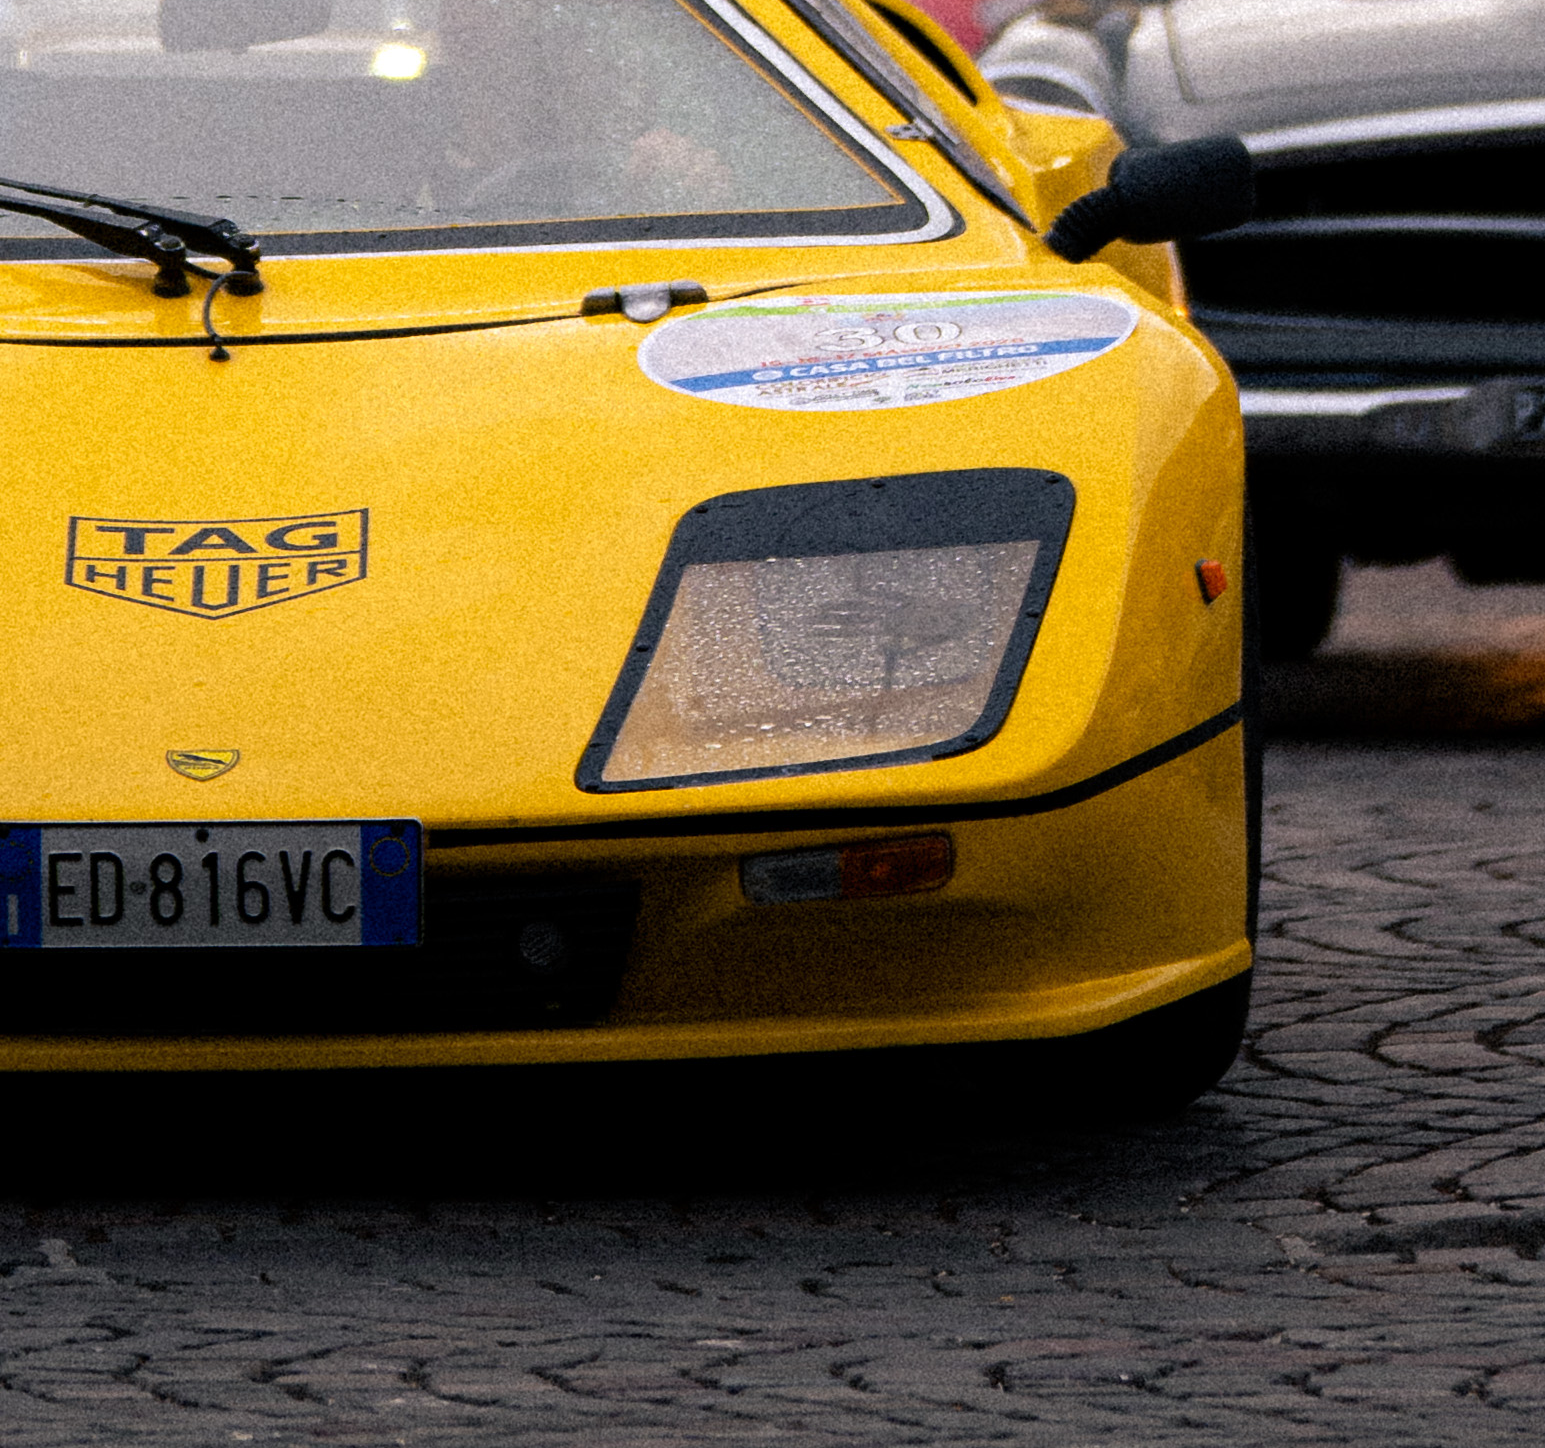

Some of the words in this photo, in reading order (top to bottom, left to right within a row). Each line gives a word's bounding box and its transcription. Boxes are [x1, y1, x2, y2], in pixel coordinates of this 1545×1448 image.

[814, 321, 963, 351] 30
[790, 359, 870, 377] CASA
[876, 351, 931, 369] DEL
[937, 344, 1039, 362] FILTRO
[95, 519, 339, 556] TAG
[84, 558, 348, 612] HEUER
